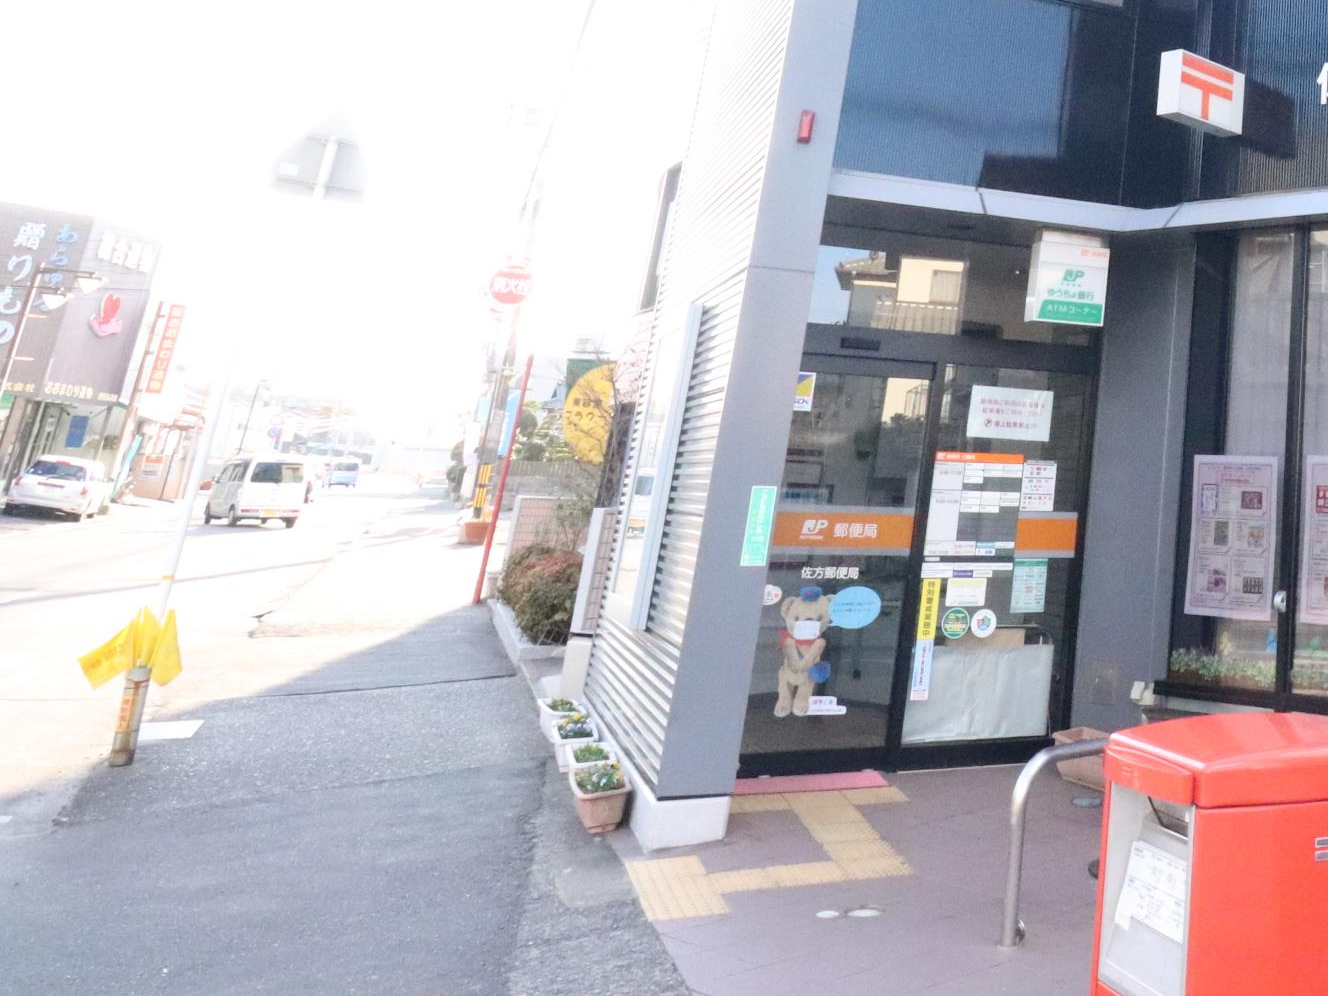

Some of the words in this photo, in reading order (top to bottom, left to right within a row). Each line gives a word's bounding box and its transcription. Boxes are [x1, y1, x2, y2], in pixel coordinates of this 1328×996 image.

[833, 522, 878, 539] 郵便局
[801, 566, 860, 580] 佐方郵便局
